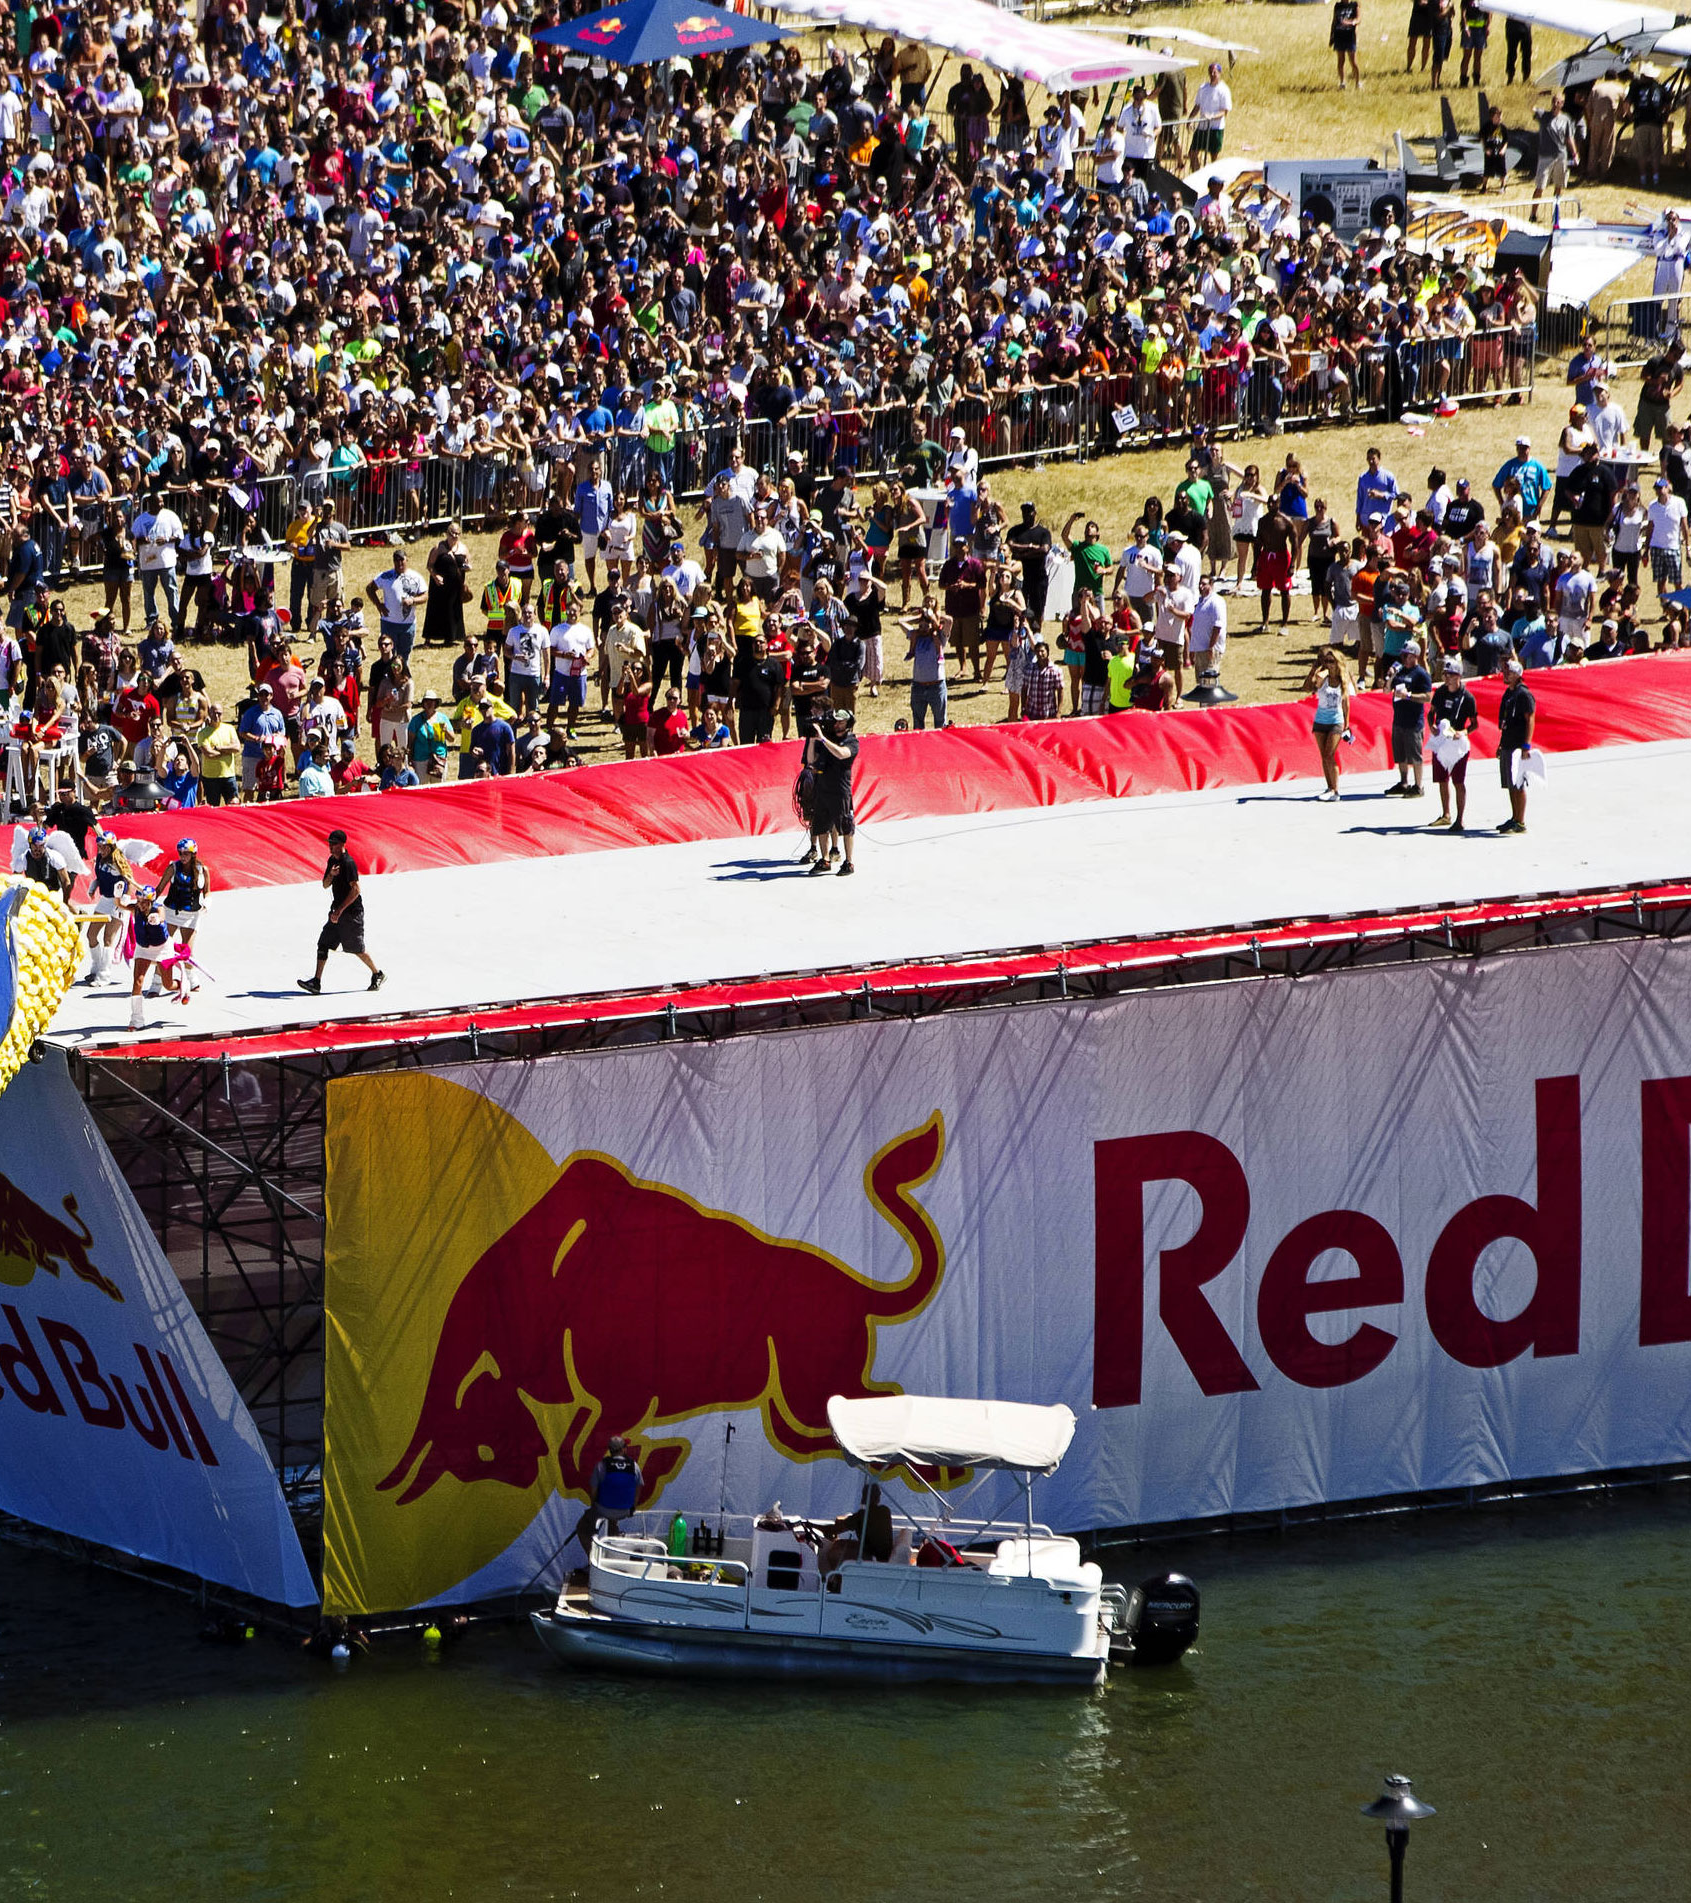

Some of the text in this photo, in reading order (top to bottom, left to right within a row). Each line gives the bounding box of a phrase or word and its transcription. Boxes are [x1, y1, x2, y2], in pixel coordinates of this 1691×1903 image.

[1092, 1074, 1581, 1410] Red
[36, 1315, 220, 1467] Bull
[1148, 1601, 1193, 1610] MERCURY
